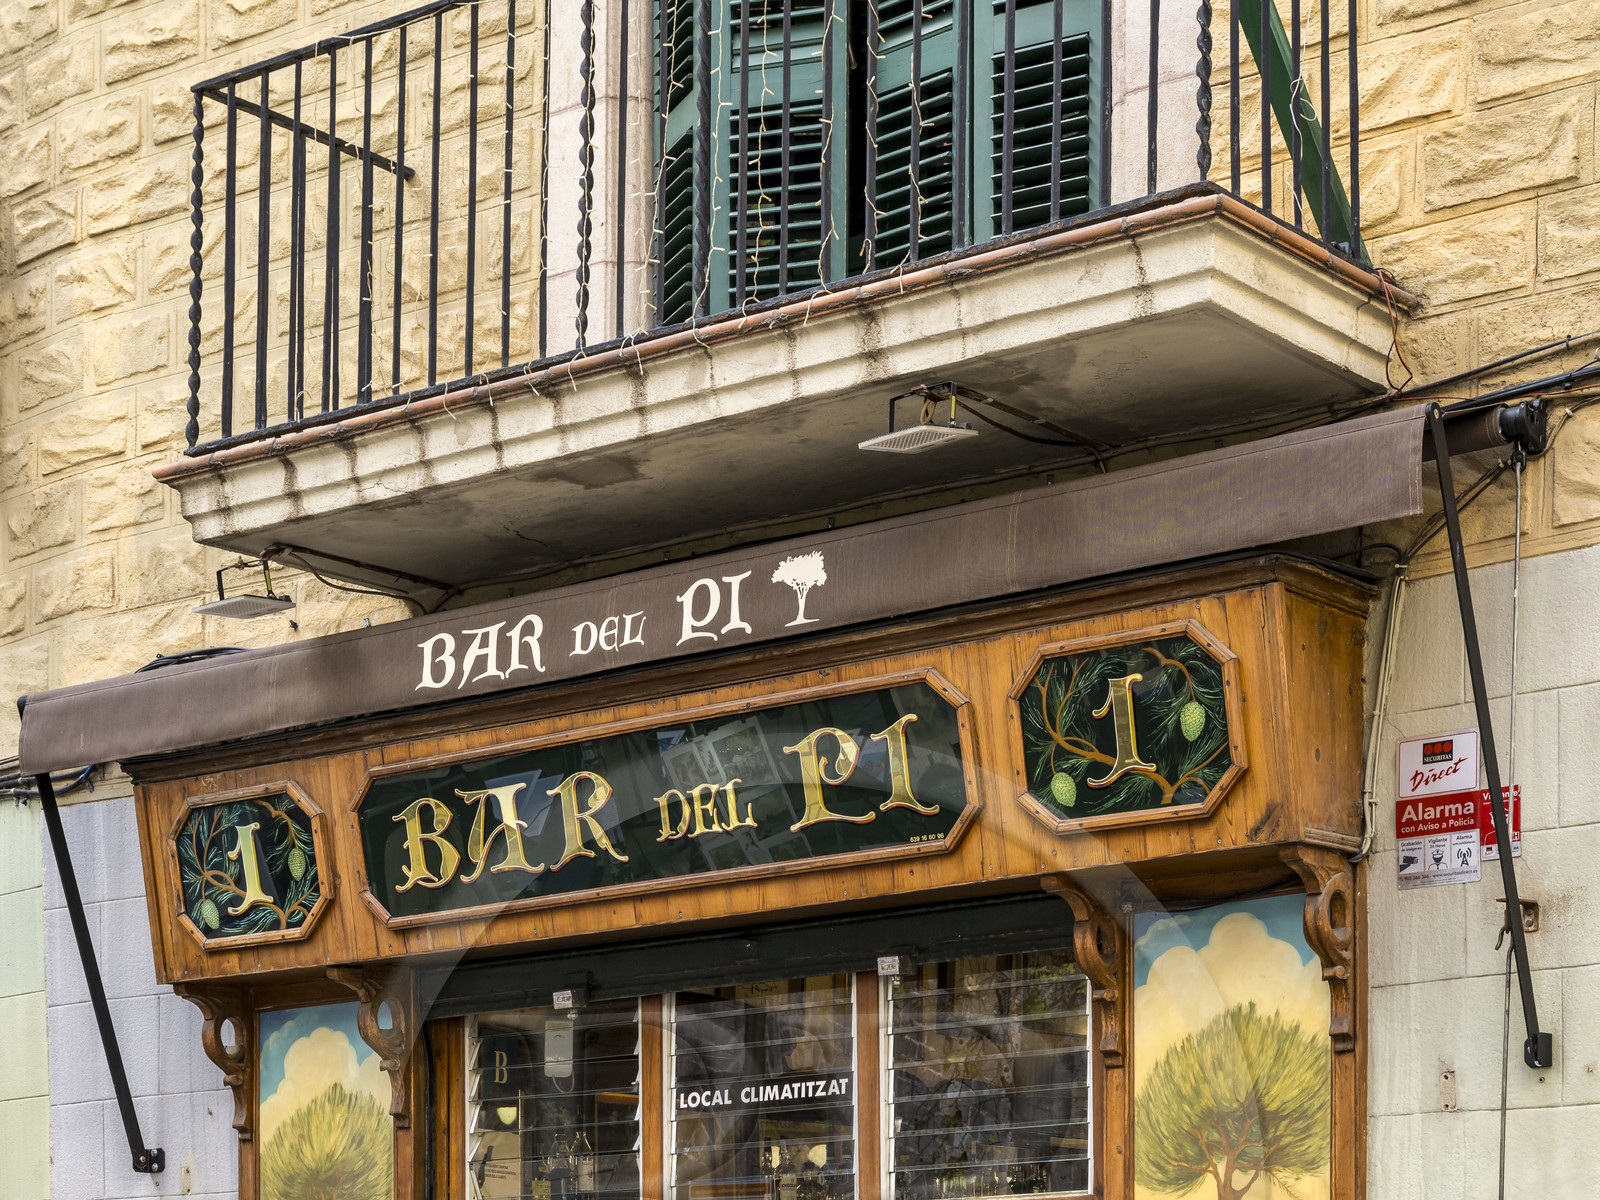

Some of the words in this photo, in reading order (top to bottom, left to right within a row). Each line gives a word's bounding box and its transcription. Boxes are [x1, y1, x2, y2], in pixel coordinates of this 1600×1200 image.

[415, 614, 545, 690] BAR
[570, 611, 646, 657] DEL
[676, 571, 751, 647] PI
[1424, 754, 1451, 762] SECURITAS
[1410, 757, 1468, 792] Direct
[392, 771, 629, 893] BAR
[653, 779, 758, 842] DEL
[783, 713, 940, 832] PI
[1401, 802, 1474, 822] Alarma
[1418, 823, 1439, 831] Aviso
[1449, 817, 1474, 827] Policía
[680, 1089, 732, 1109] LOCAL
[740, 1078, 848, 1103] CLIMATITZAT
